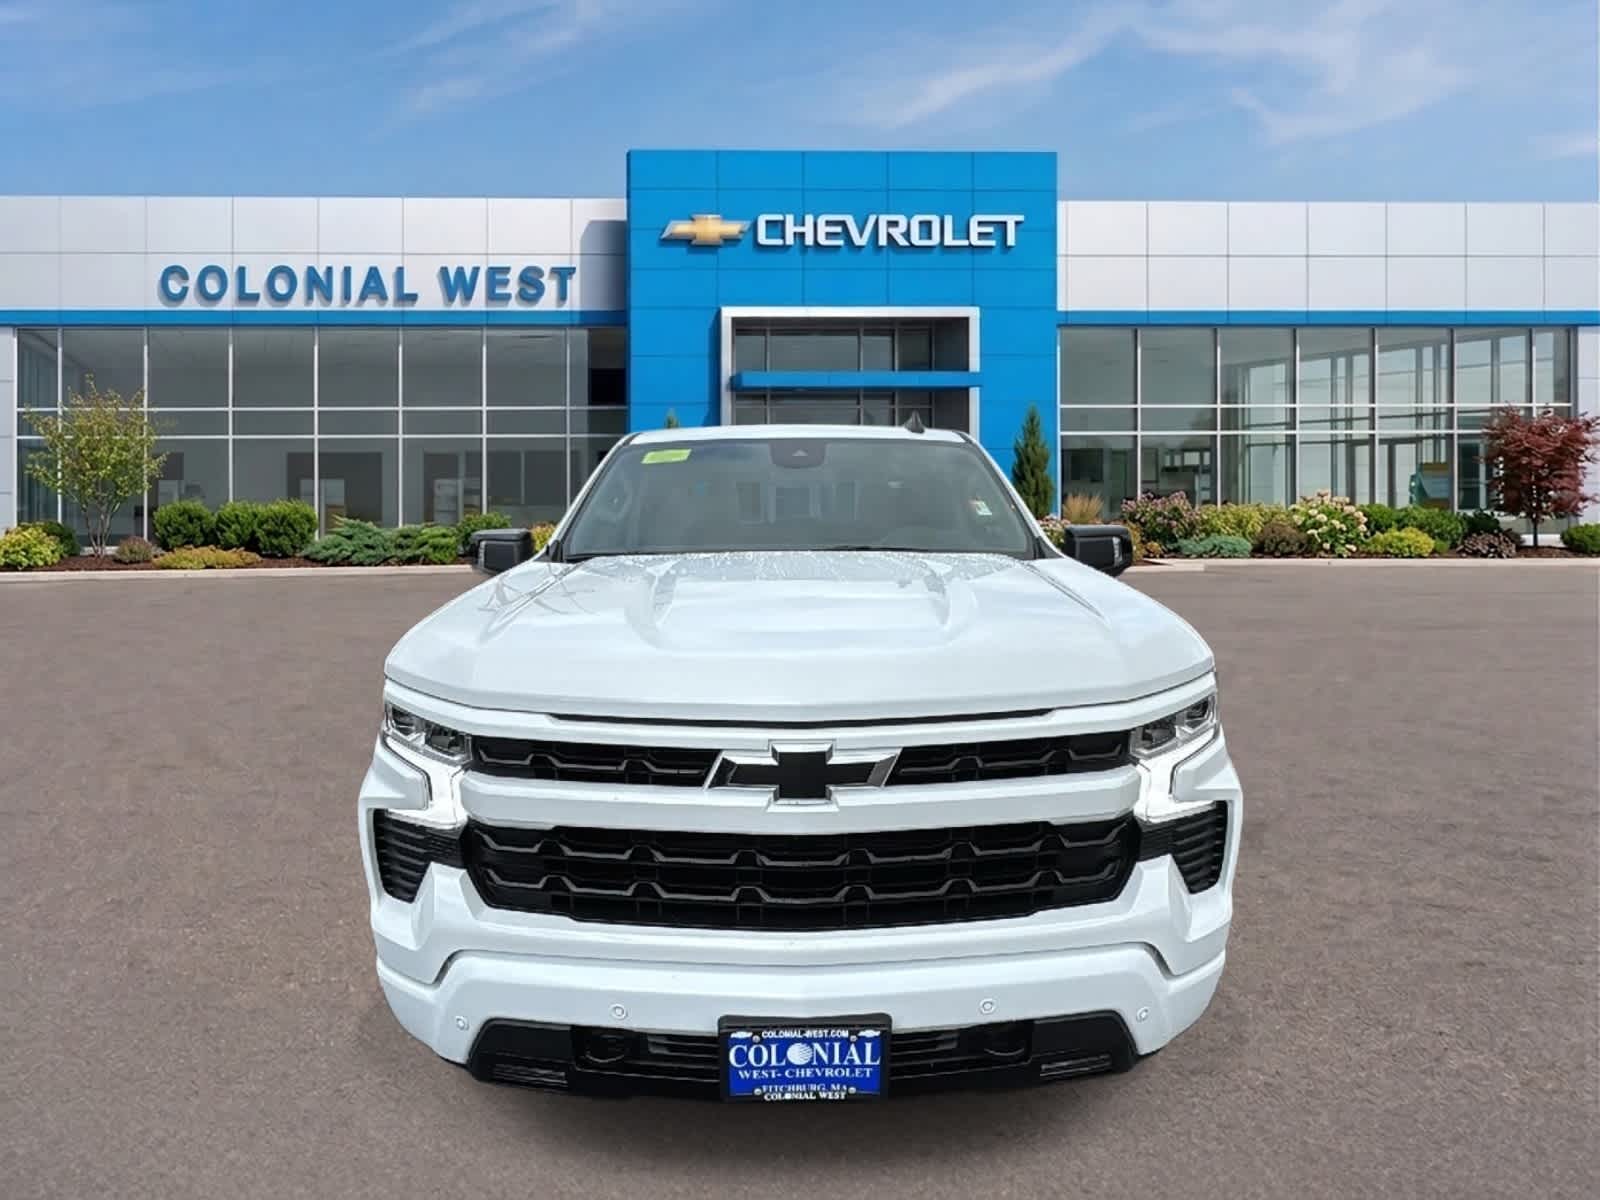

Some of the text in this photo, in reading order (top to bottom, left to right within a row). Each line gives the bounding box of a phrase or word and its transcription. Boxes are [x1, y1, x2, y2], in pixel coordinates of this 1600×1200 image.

[757, 213, 1025, 247] CHEVROLET
[159, 264, 577, 305] COLONIAL WEST
[761, 1029, 849, 1038] COLONIAL-WEST.COM
[729, 1042, 881, 1068] COLONIAL
[785, 1067, 873, 1079] CHEVROLET
[764, 1090, 846, 1101] COLONIAL WEST
